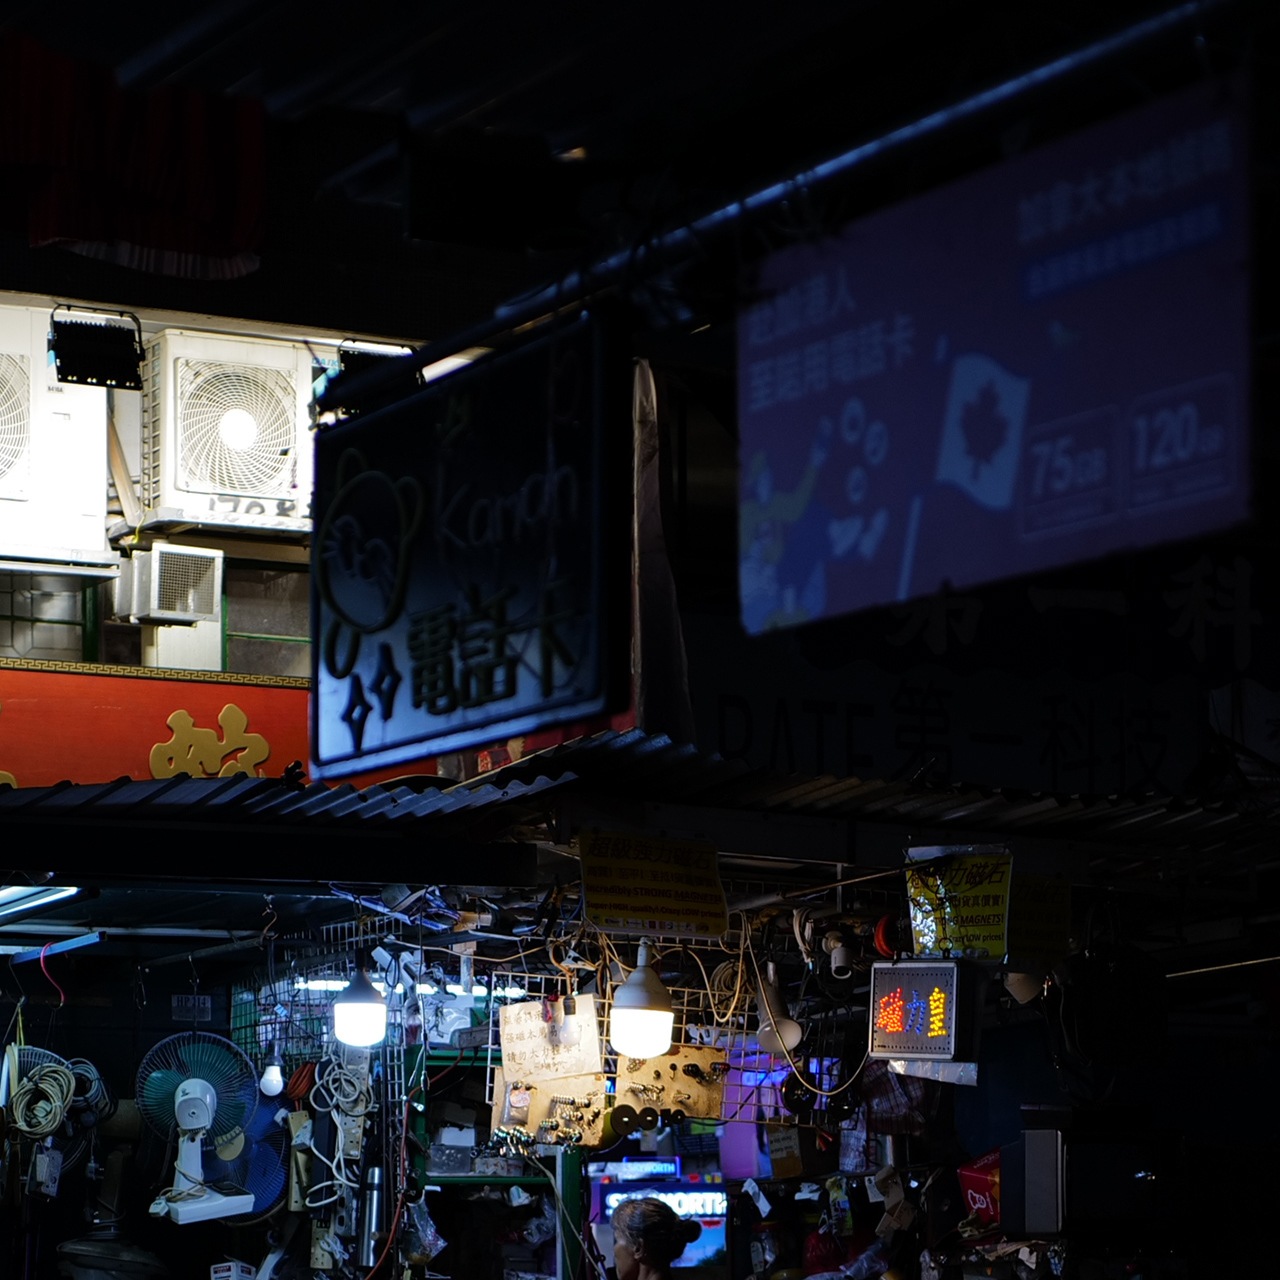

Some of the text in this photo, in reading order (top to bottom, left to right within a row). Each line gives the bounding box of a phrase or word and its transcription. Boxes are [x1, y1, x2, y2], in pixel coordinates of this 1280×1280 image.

[410, 582, 588, 715] 電話卡
[633, 887, 673, 899] STRONG
